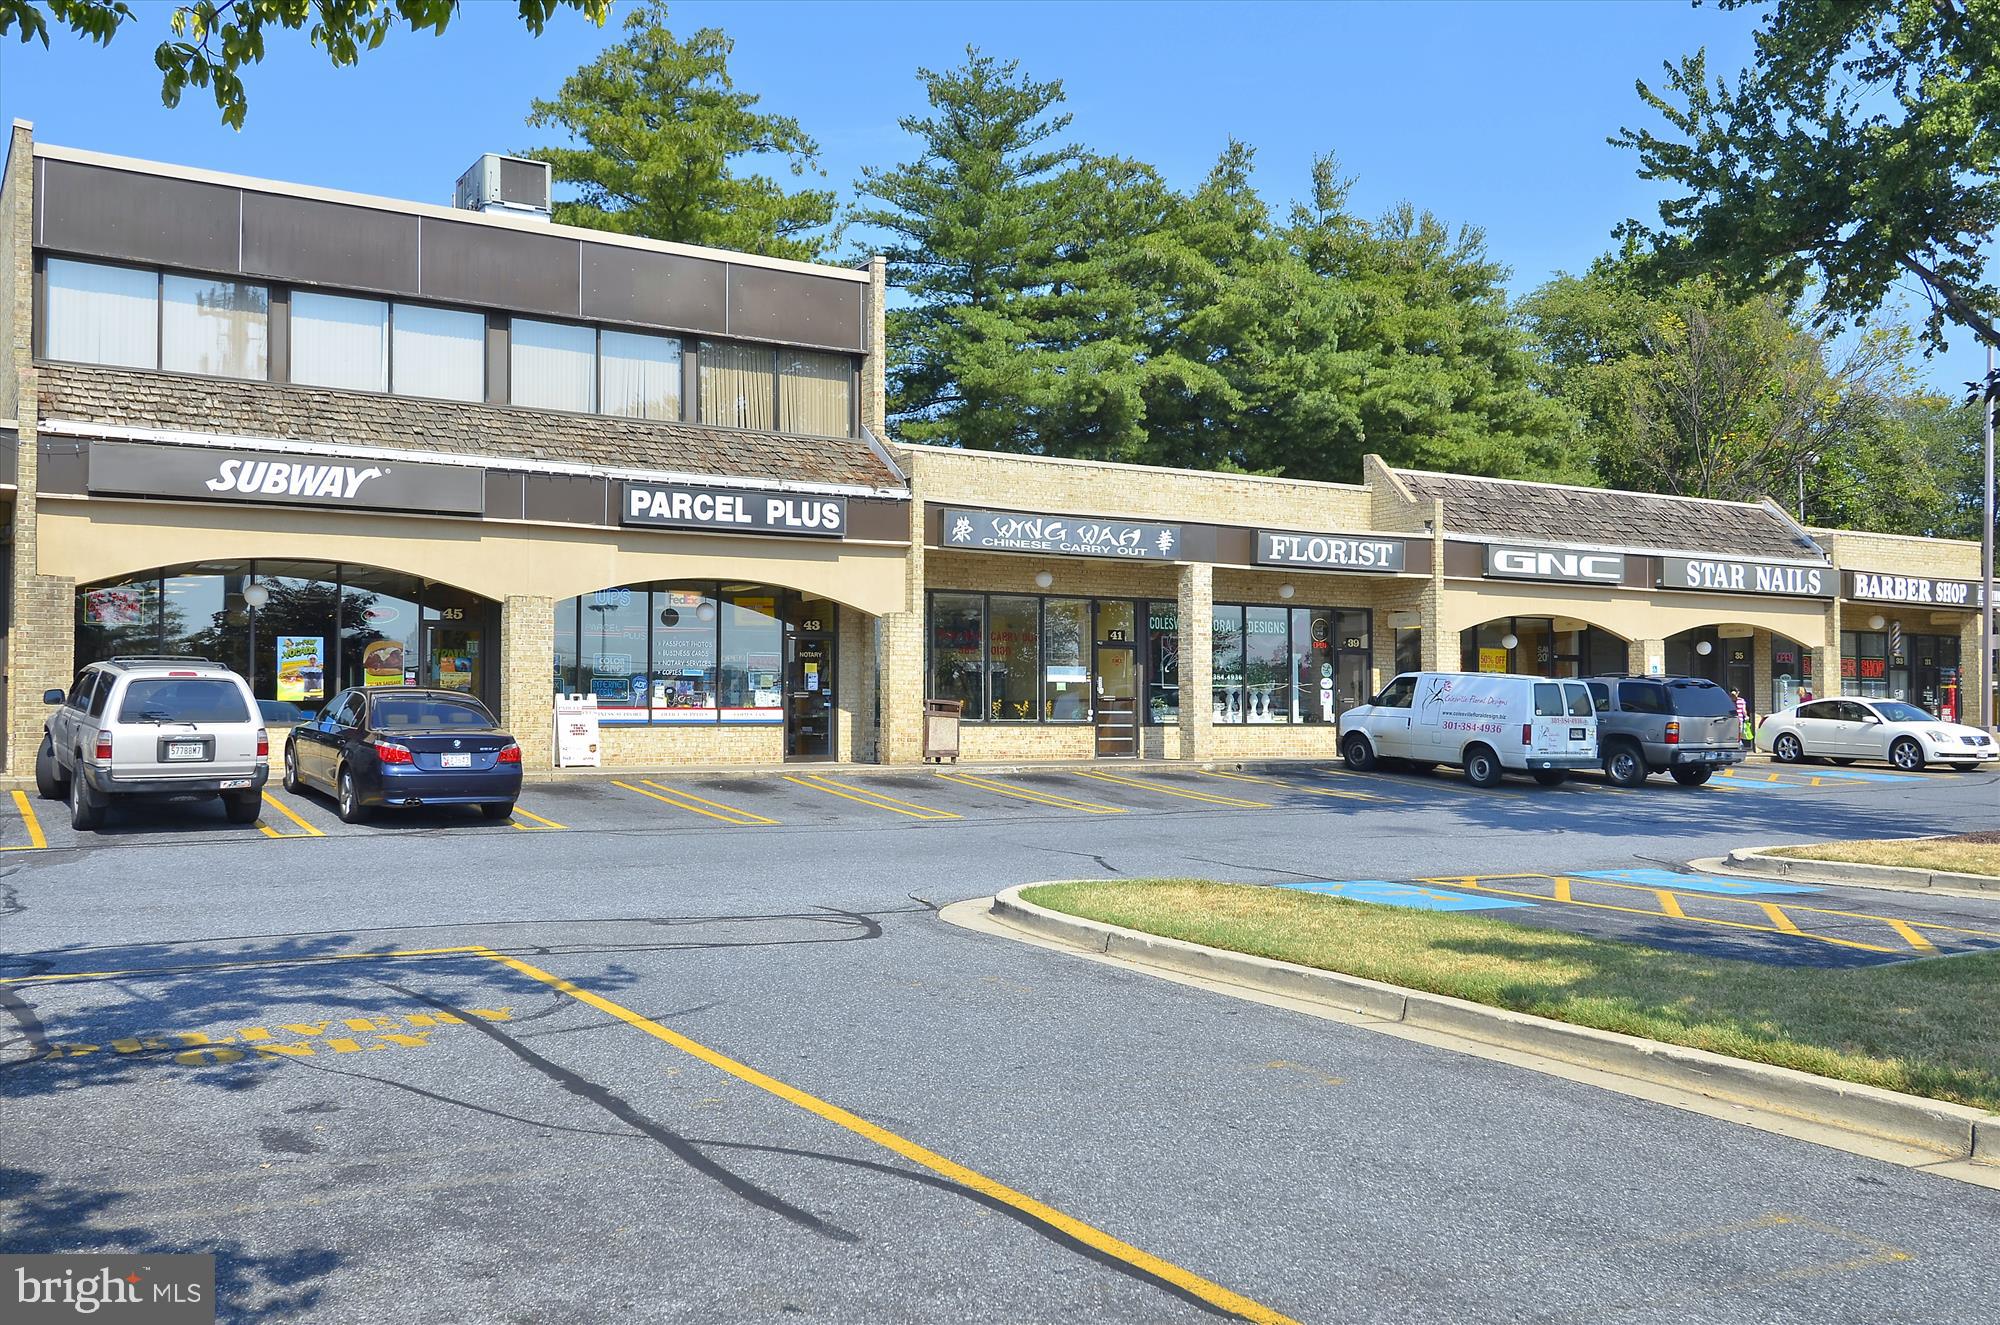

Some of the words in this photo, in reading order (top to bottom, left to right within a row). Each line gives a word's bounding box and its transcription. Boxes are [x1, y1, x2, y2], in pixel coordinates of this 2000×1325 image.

[205, 459, 382, 498] SUBWAY
[631, 489, 752, 523] PARCEL
[767, 499, 840, 529] PLUS
[982, 537, 1051, 550] CHINESE
[1060, 542, 1111, 554] CARRY
[1117, 547, 1148, 556] OUT
[1269, 535, 1393, 567] FLORIST
[1494, 549, 1621, 579] GNC
[1686, 560, 1745, 590] STAR
[1755, 566, 1821, 595] NAILS
[1855, 574, 1932, 602] BARBER
[1935, 582, 1967, 604] SHOP
[595, 588, 631, 606] UPS
[443, 608, 463, 620] 45
[584, 623, 621, 632] PARCEL
[804, 620, 821, 630] 43
[1212, 620, 1237, 632] ORAL
[1248, 621, 1286, 634] DESIGNS
[623, 631, 647, 640] PLUS
[1110, 631, 1122, 640] 41
[662, 640, 689, 648] PASSPORT
[690, 640, 713, 648] PHOTOS
[1312, 641, 1328, 649] OPEN
[1347, 639, 1360, 648] 39
[662, 649, 690, 657] BUSINESS
[1734, 652, 1744, 660] 35
[599, 657, 625, 665] COLOR
[662, 659, 685, 667] NOTARY
[1480, 655, 1493, 665] 50%
[1495, 656, 1505, 665] OFF
[1895, 657, 1904, 665] 33
[1861, 659, 1885, 677] SHOP
